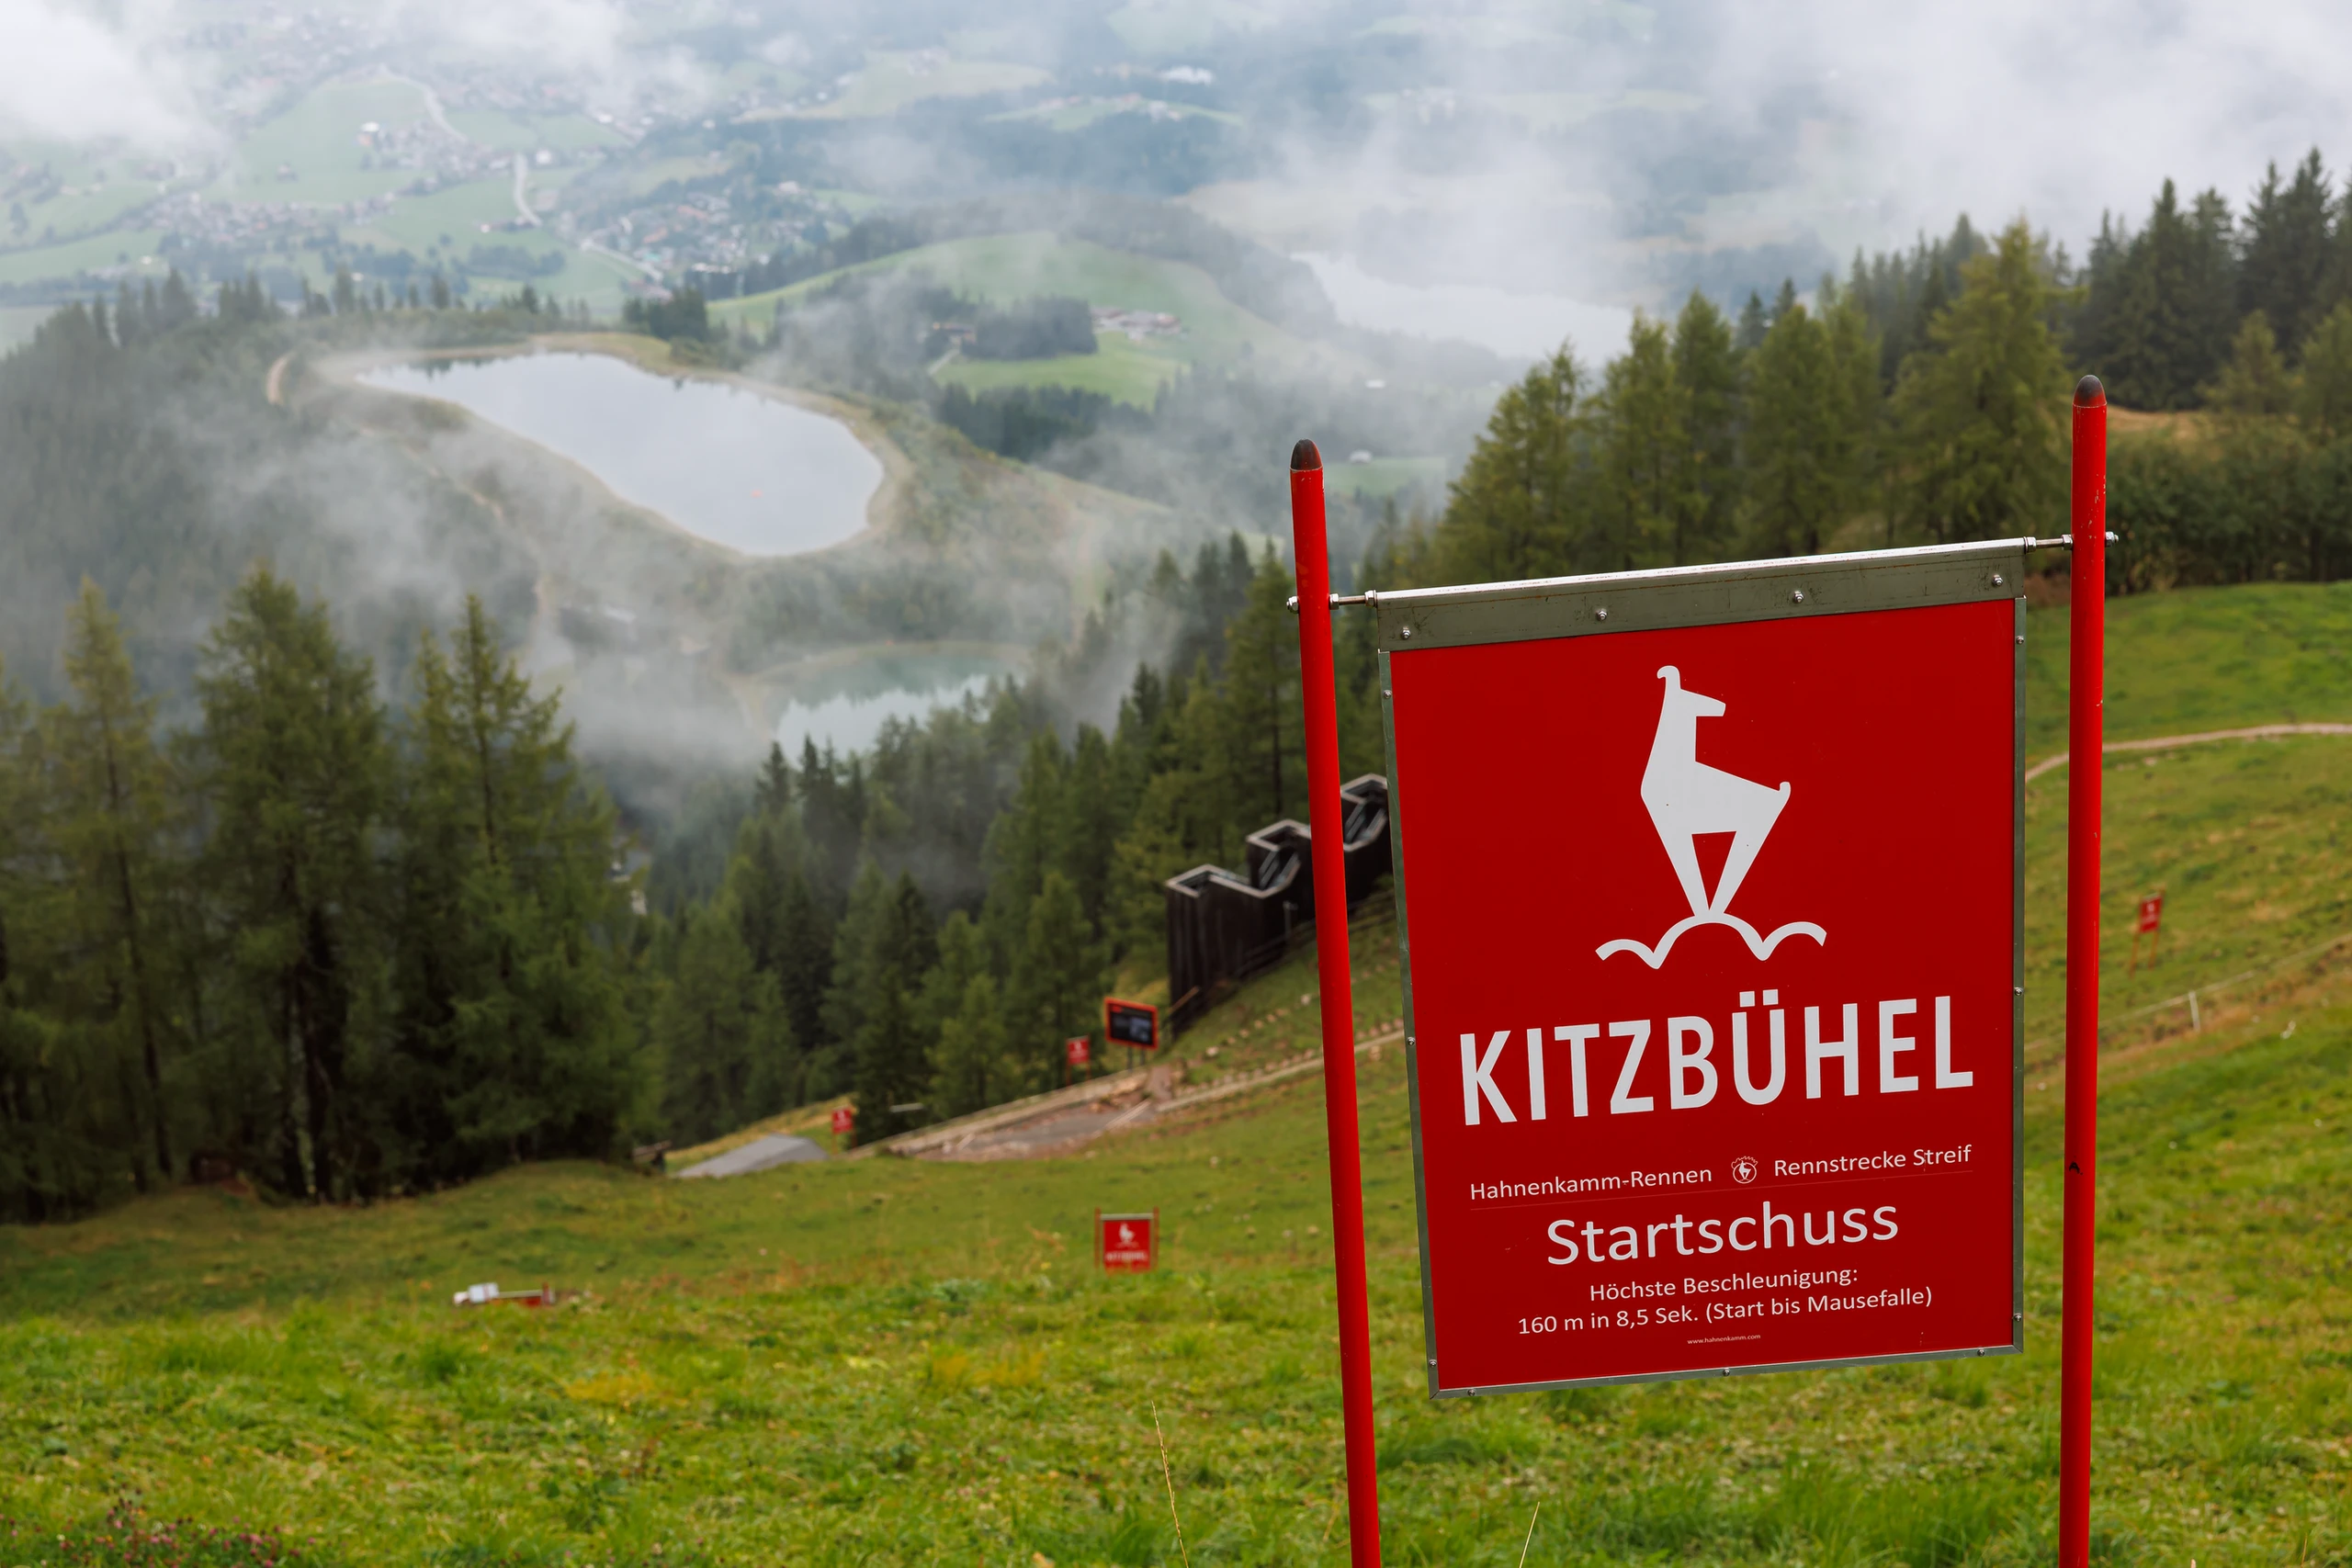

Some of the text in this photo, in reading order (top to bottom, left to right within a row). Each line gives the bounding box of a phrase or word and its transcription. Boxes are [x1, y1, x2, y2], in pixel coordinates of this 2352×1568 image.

[1460, 989, 1973, 1126] KITZBÜHEL
[1470, 1144, 1973, 1201] Hahnenkamm-Rennen Rennstrecke Streif
[1547, 1201, 1899, 1266] Startschuss
[1518, 1286, 1932, 1335] 160 m in 8,5 Sek. (Start bis Mausefalle)
[1590, 1269, 1858, 1302] Höchste Beschleunigung:
[1687, 1335, 1761, 1345] www.hahnenkamm.com
